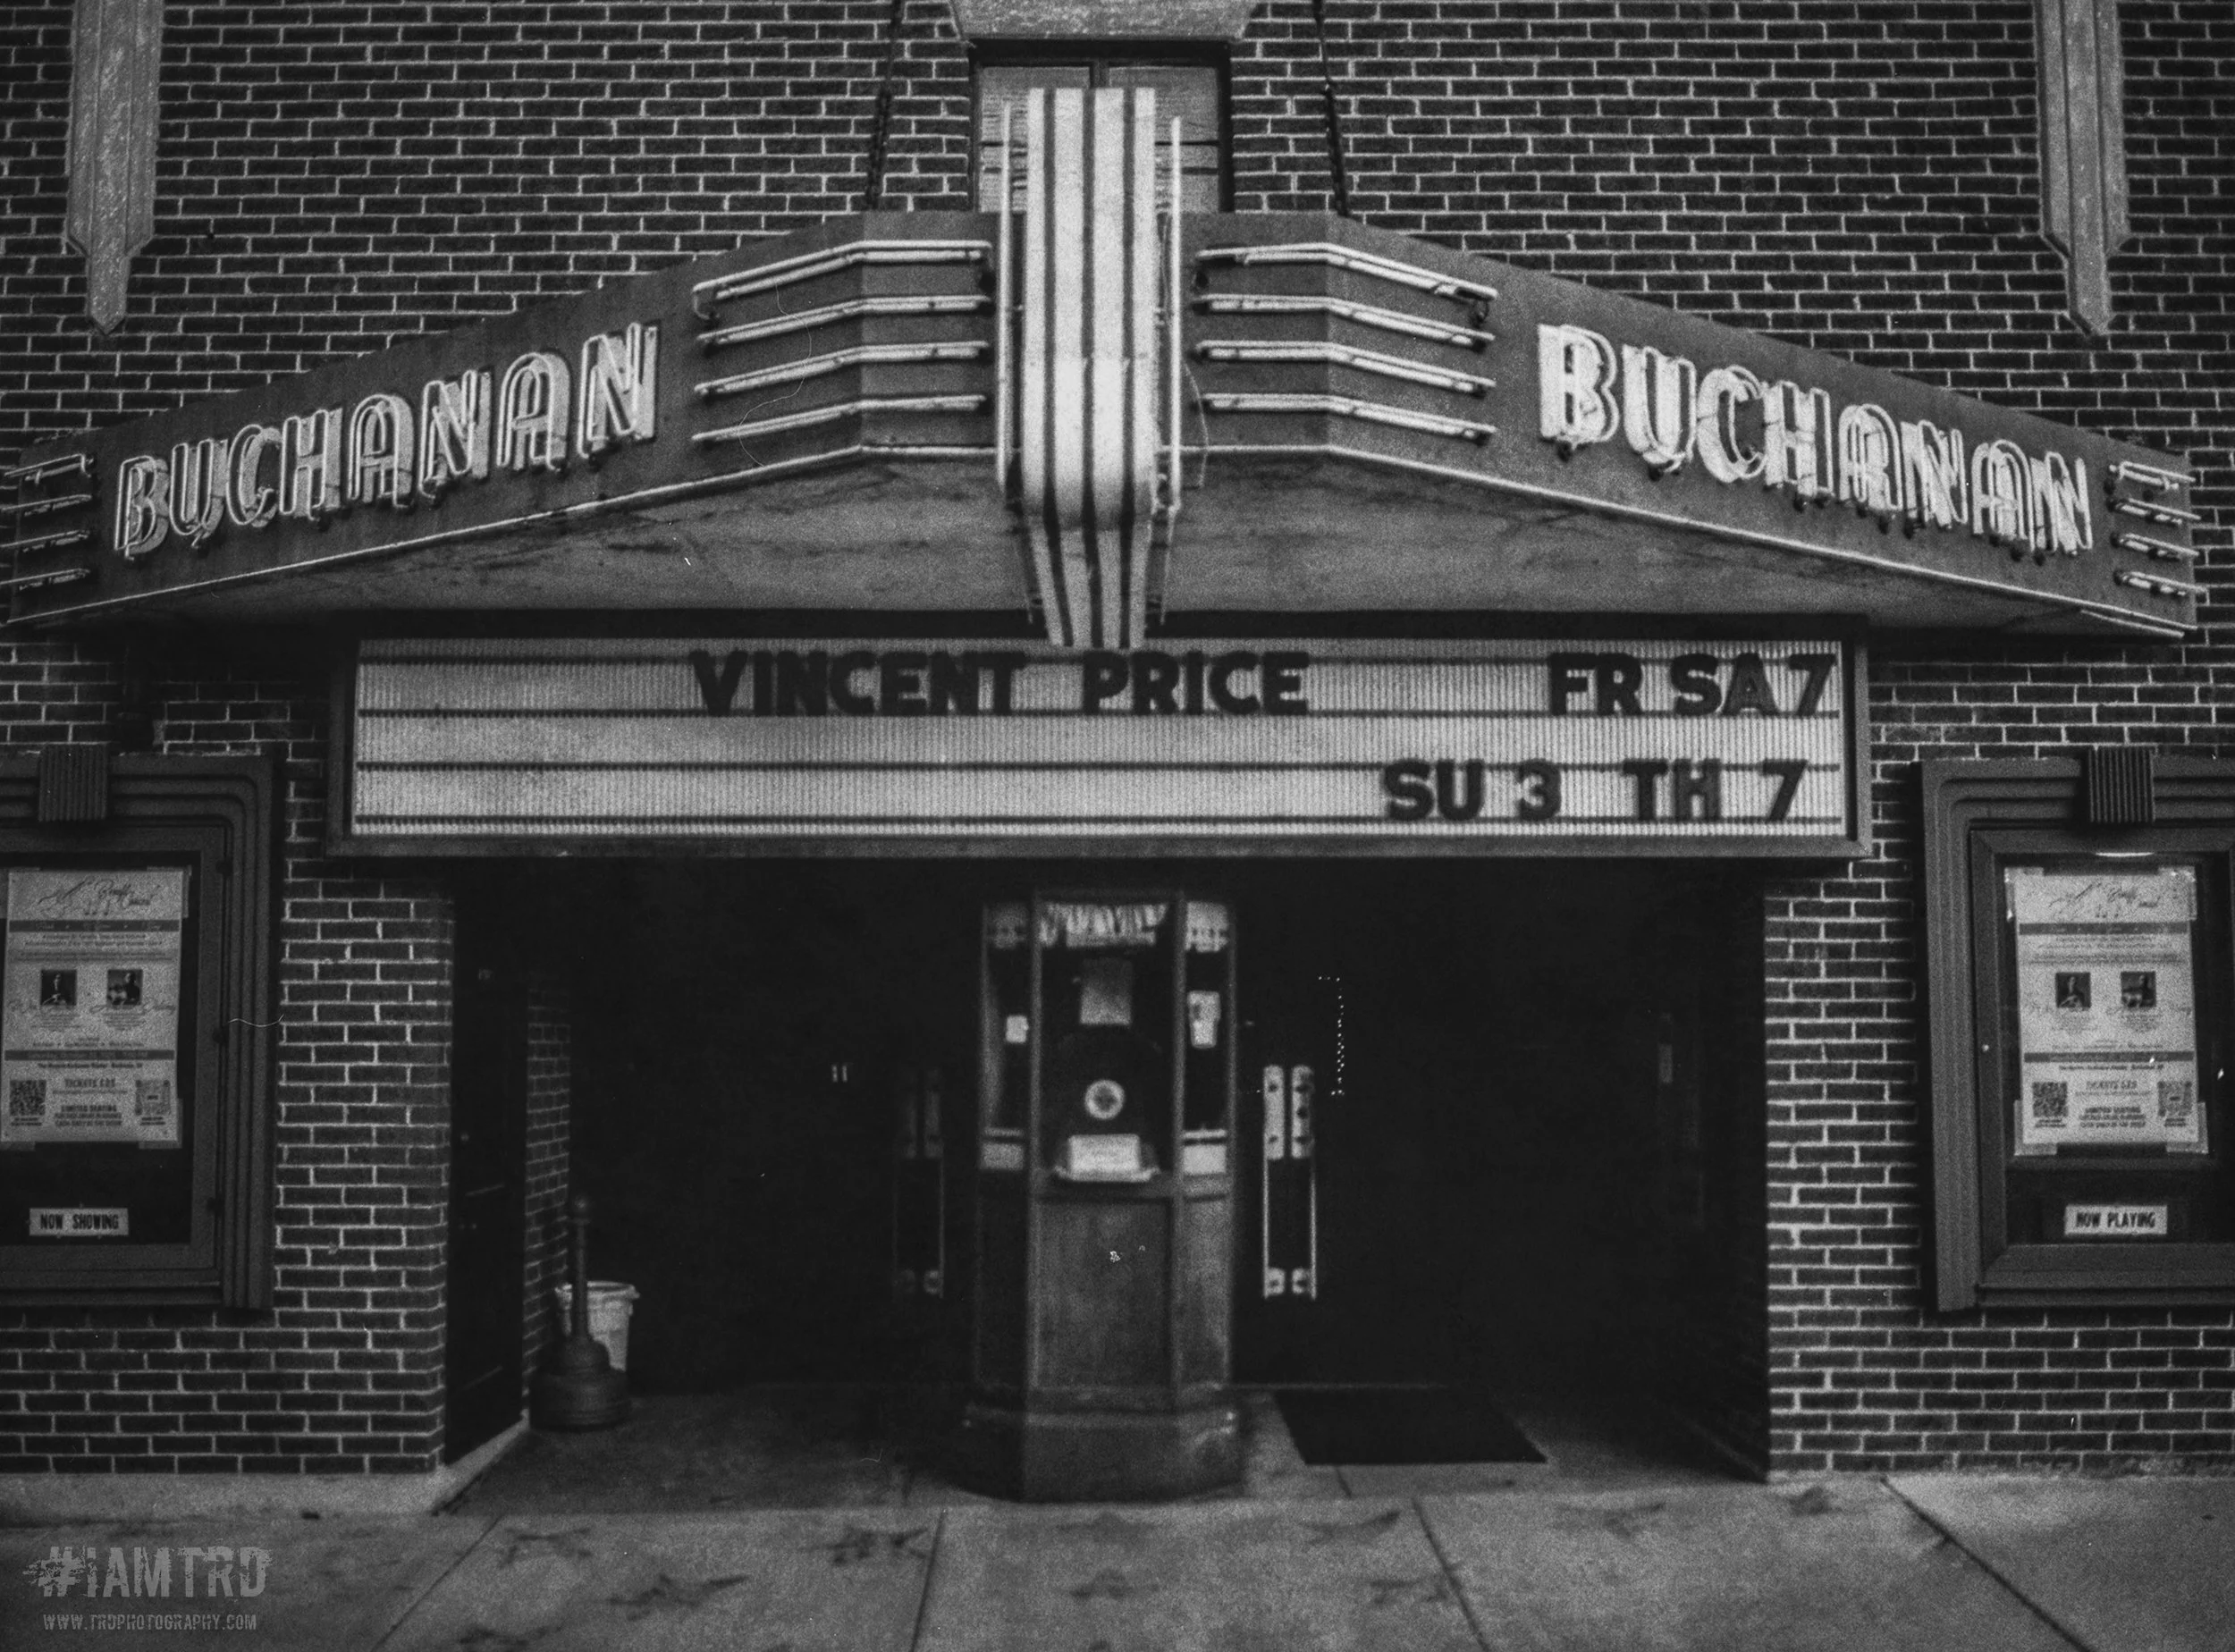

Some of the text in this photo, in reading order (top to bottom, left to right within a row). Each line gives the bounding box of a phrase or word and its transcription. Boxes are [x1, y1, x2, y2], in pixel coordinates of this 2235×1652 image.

[114, 322, 659, 560] BUCHANAN
[1537, 323, 2094, 555] BUCHANAN
[687, 651, 1309, 714] VINCENT PRICE
[1385, 758, 1809, 822] SU 3 TH 7
[40, 1213, 119, 1229] NOW SHOWING
[2076, 1211, 2155, 1228] NOW PLAYING
